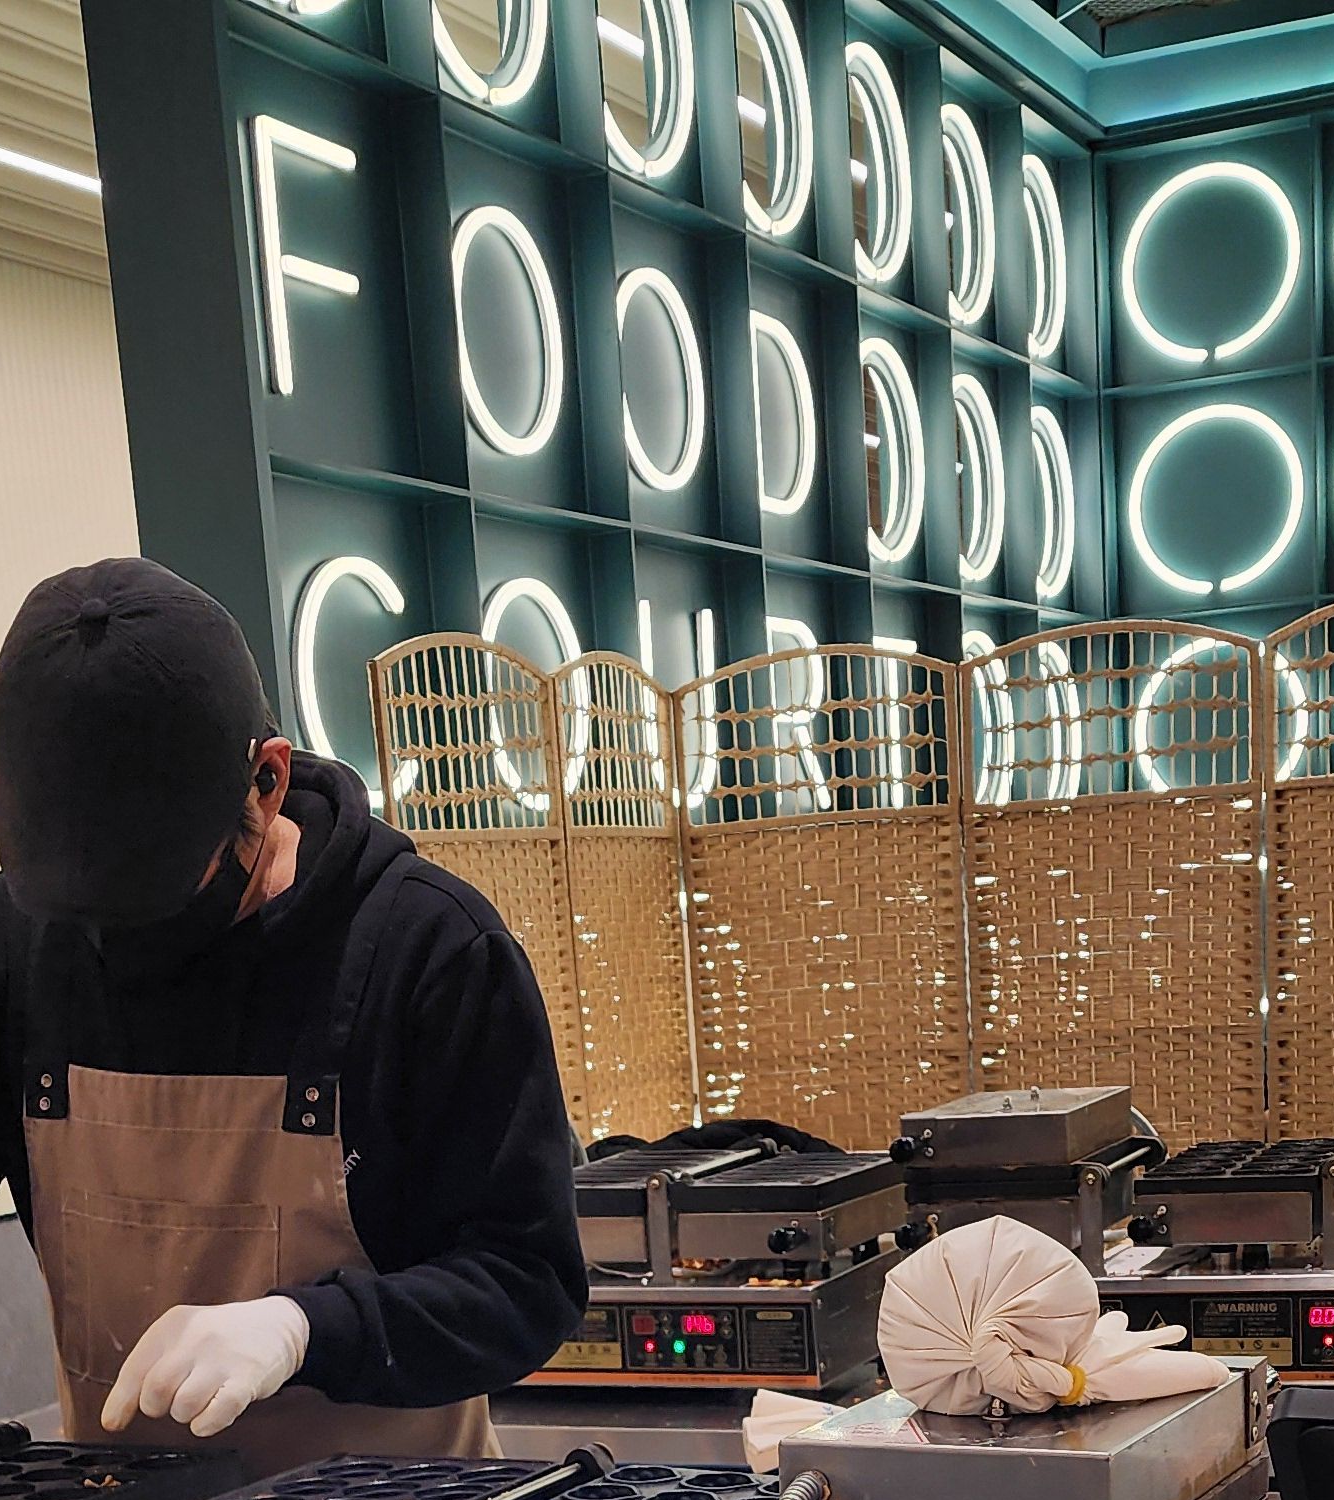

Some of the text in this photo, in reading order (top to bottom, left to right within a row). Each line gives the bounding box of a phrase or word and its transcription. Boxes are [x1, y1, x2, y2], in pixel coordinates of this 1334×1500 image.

[249, 115, 815, 515] FOOD
[294, 555, 919, 810] COURT
[1217, 1302, 1277, 1313] WARNING
